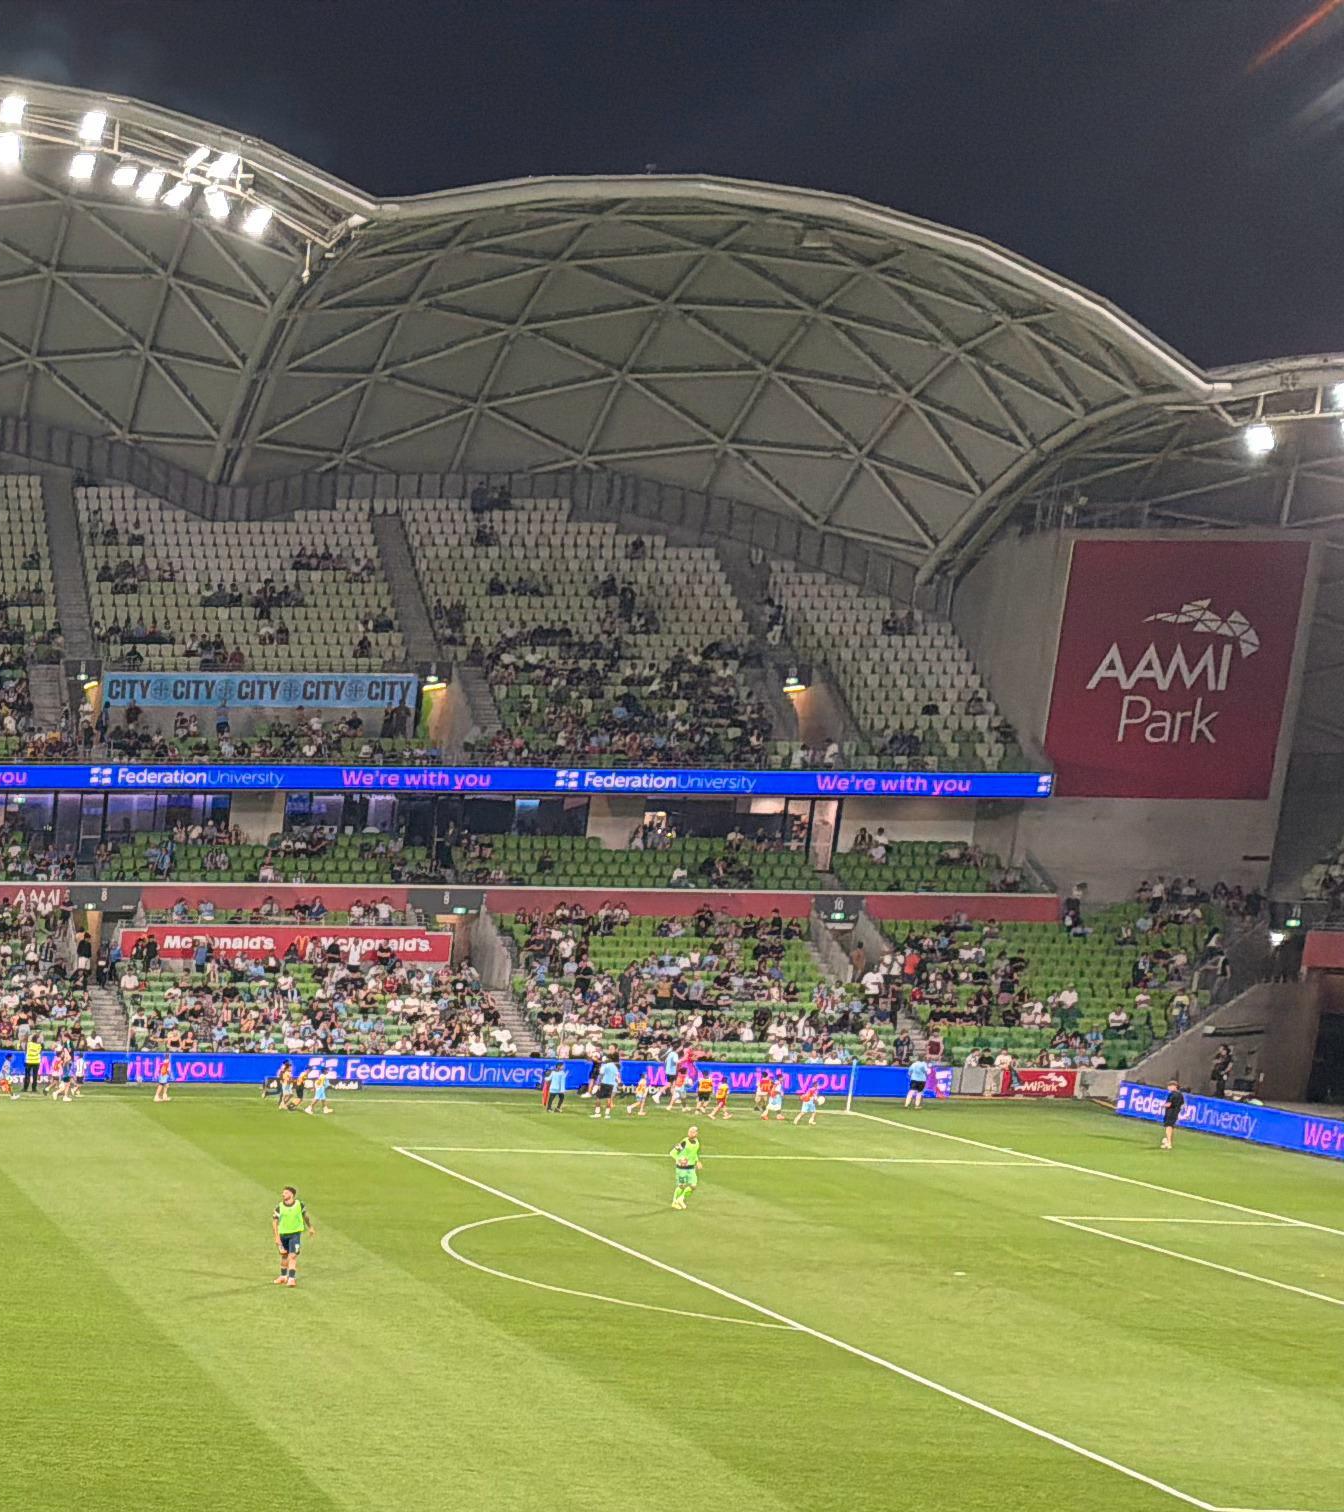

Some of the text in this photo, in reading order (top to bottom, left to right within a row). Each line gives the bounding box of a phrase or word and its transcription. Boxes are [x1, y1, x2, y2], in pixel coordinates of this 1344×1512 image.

[1086, 643, 1232, 691] AAMI
[109, 679, 410, 701] CITY CITY CITY CITY CITY
[1115, 695, 1219, 744] Park
[342, 769, 491, 790] We're with you
[816, 774, 971, 796] We're with you
[175, 1062, 224, 1082] you
